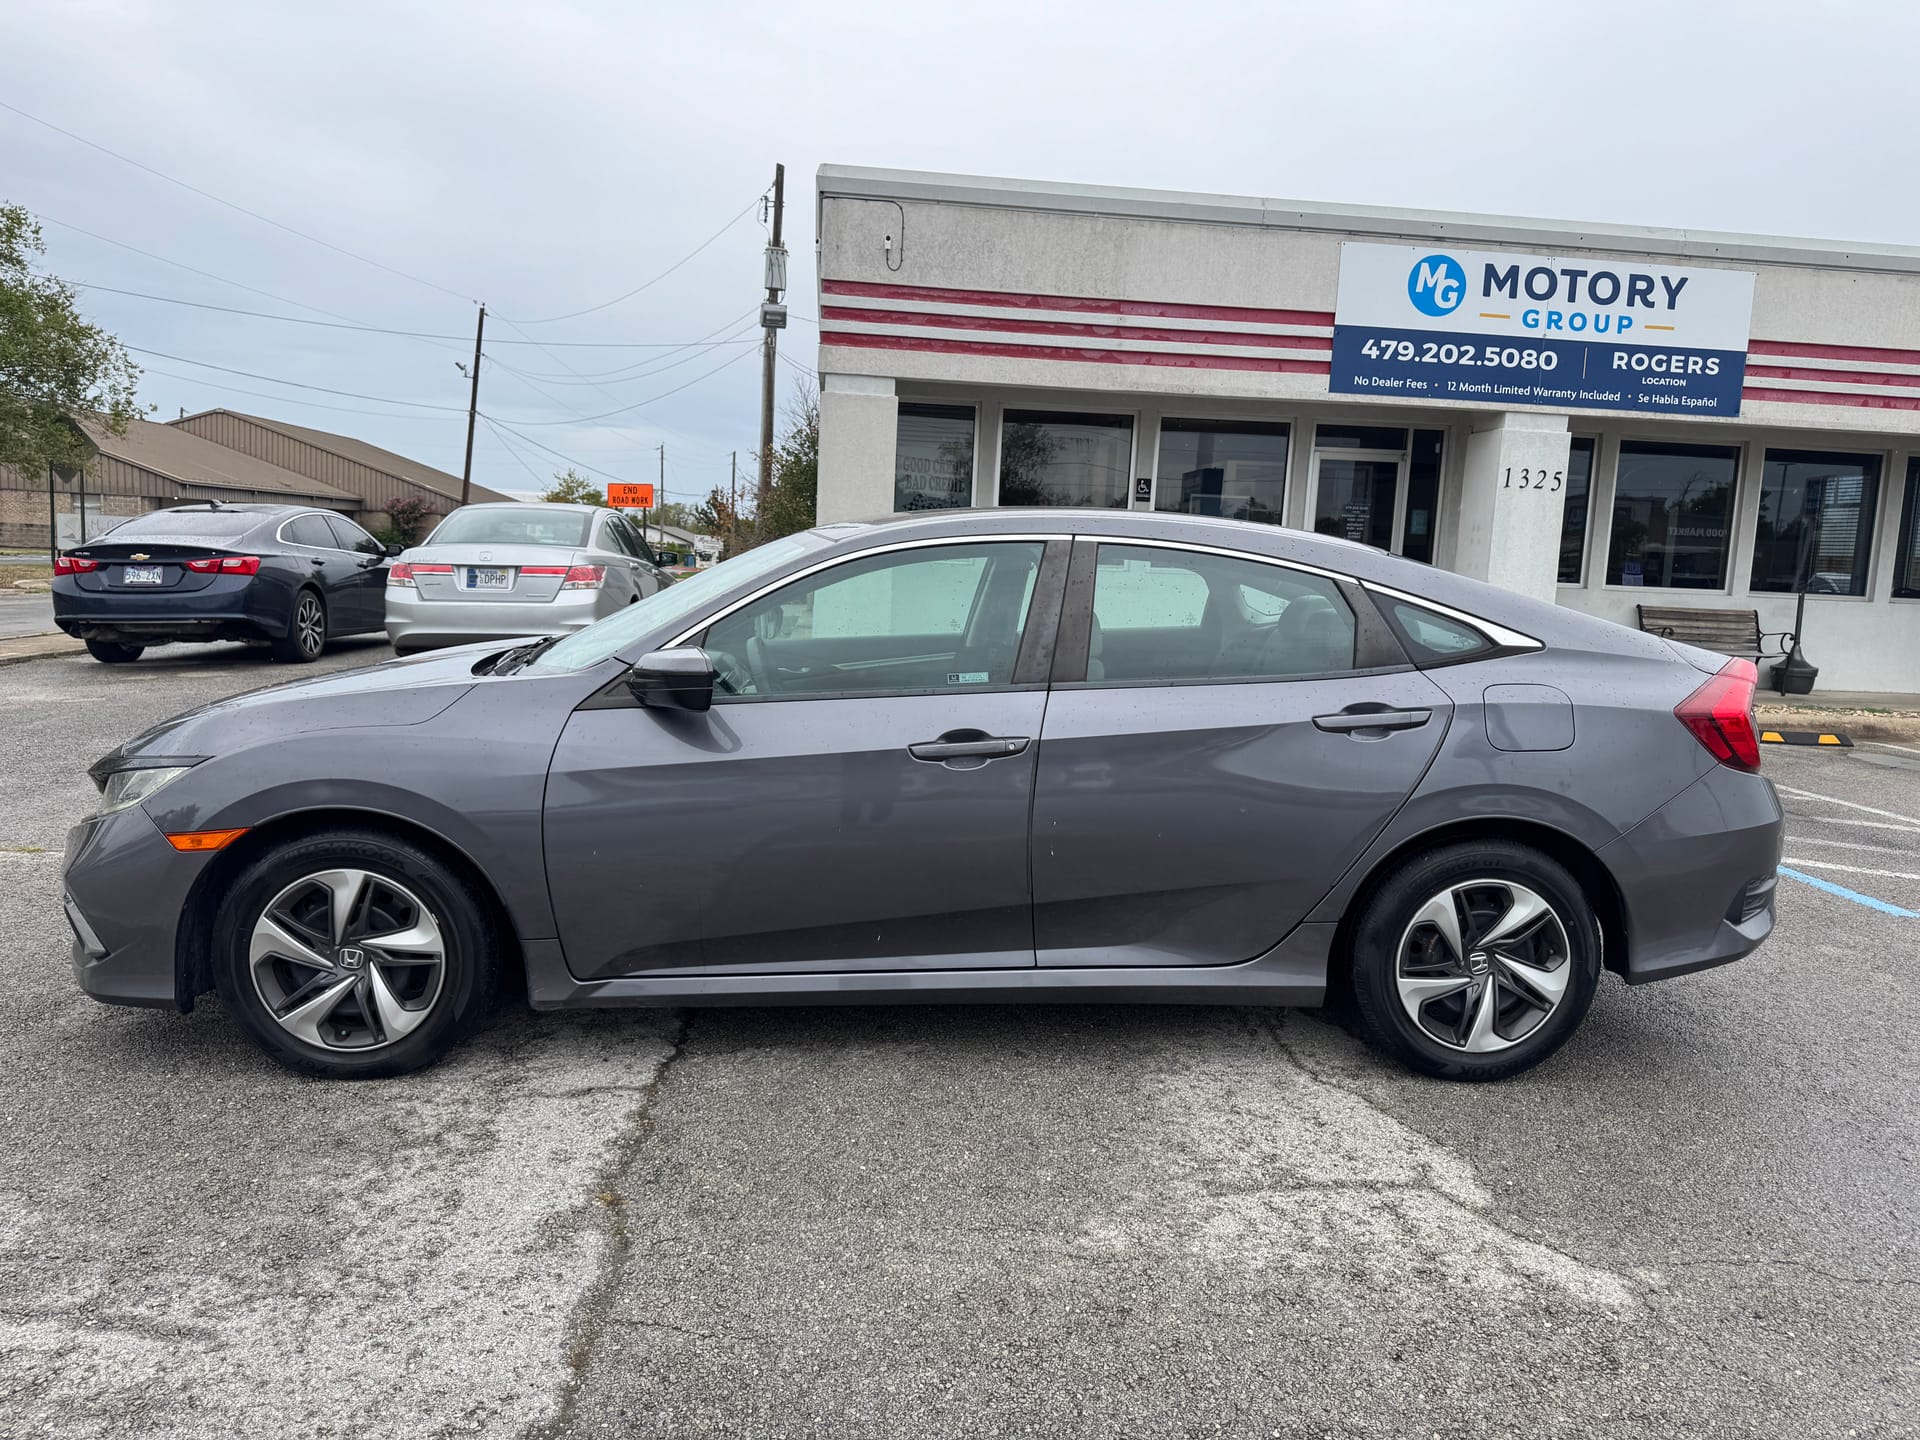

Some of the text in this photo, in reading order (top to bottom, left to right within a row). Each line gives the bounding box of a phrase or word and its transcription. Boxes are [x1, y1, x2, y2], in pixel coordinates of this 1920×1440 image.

[1415, 262, 1460, 309] MG
[1482, 262, 1689, 311] MOTORY
[1522, 309, 1633, 335] GROUP
[1361, 339, 1558, 371] 479.202.5080
[1612, 351, 1721, 376] ROGERS
[1354, 375, 1717, 408] No Dealer Fees 12 Month Limited Warranty Included Se Habla Español
[1641, 377, 1687, 387] LOCATION
[903, 456, 930, 474] GOOD
[623, 486, 638, 494] END
[904, 474, 927, 490] BAD
[1503, 467, 1563, 492] 1325
[612, 496, 649, 505] ROAD WORK
[126, 571, 141, 580] 596
